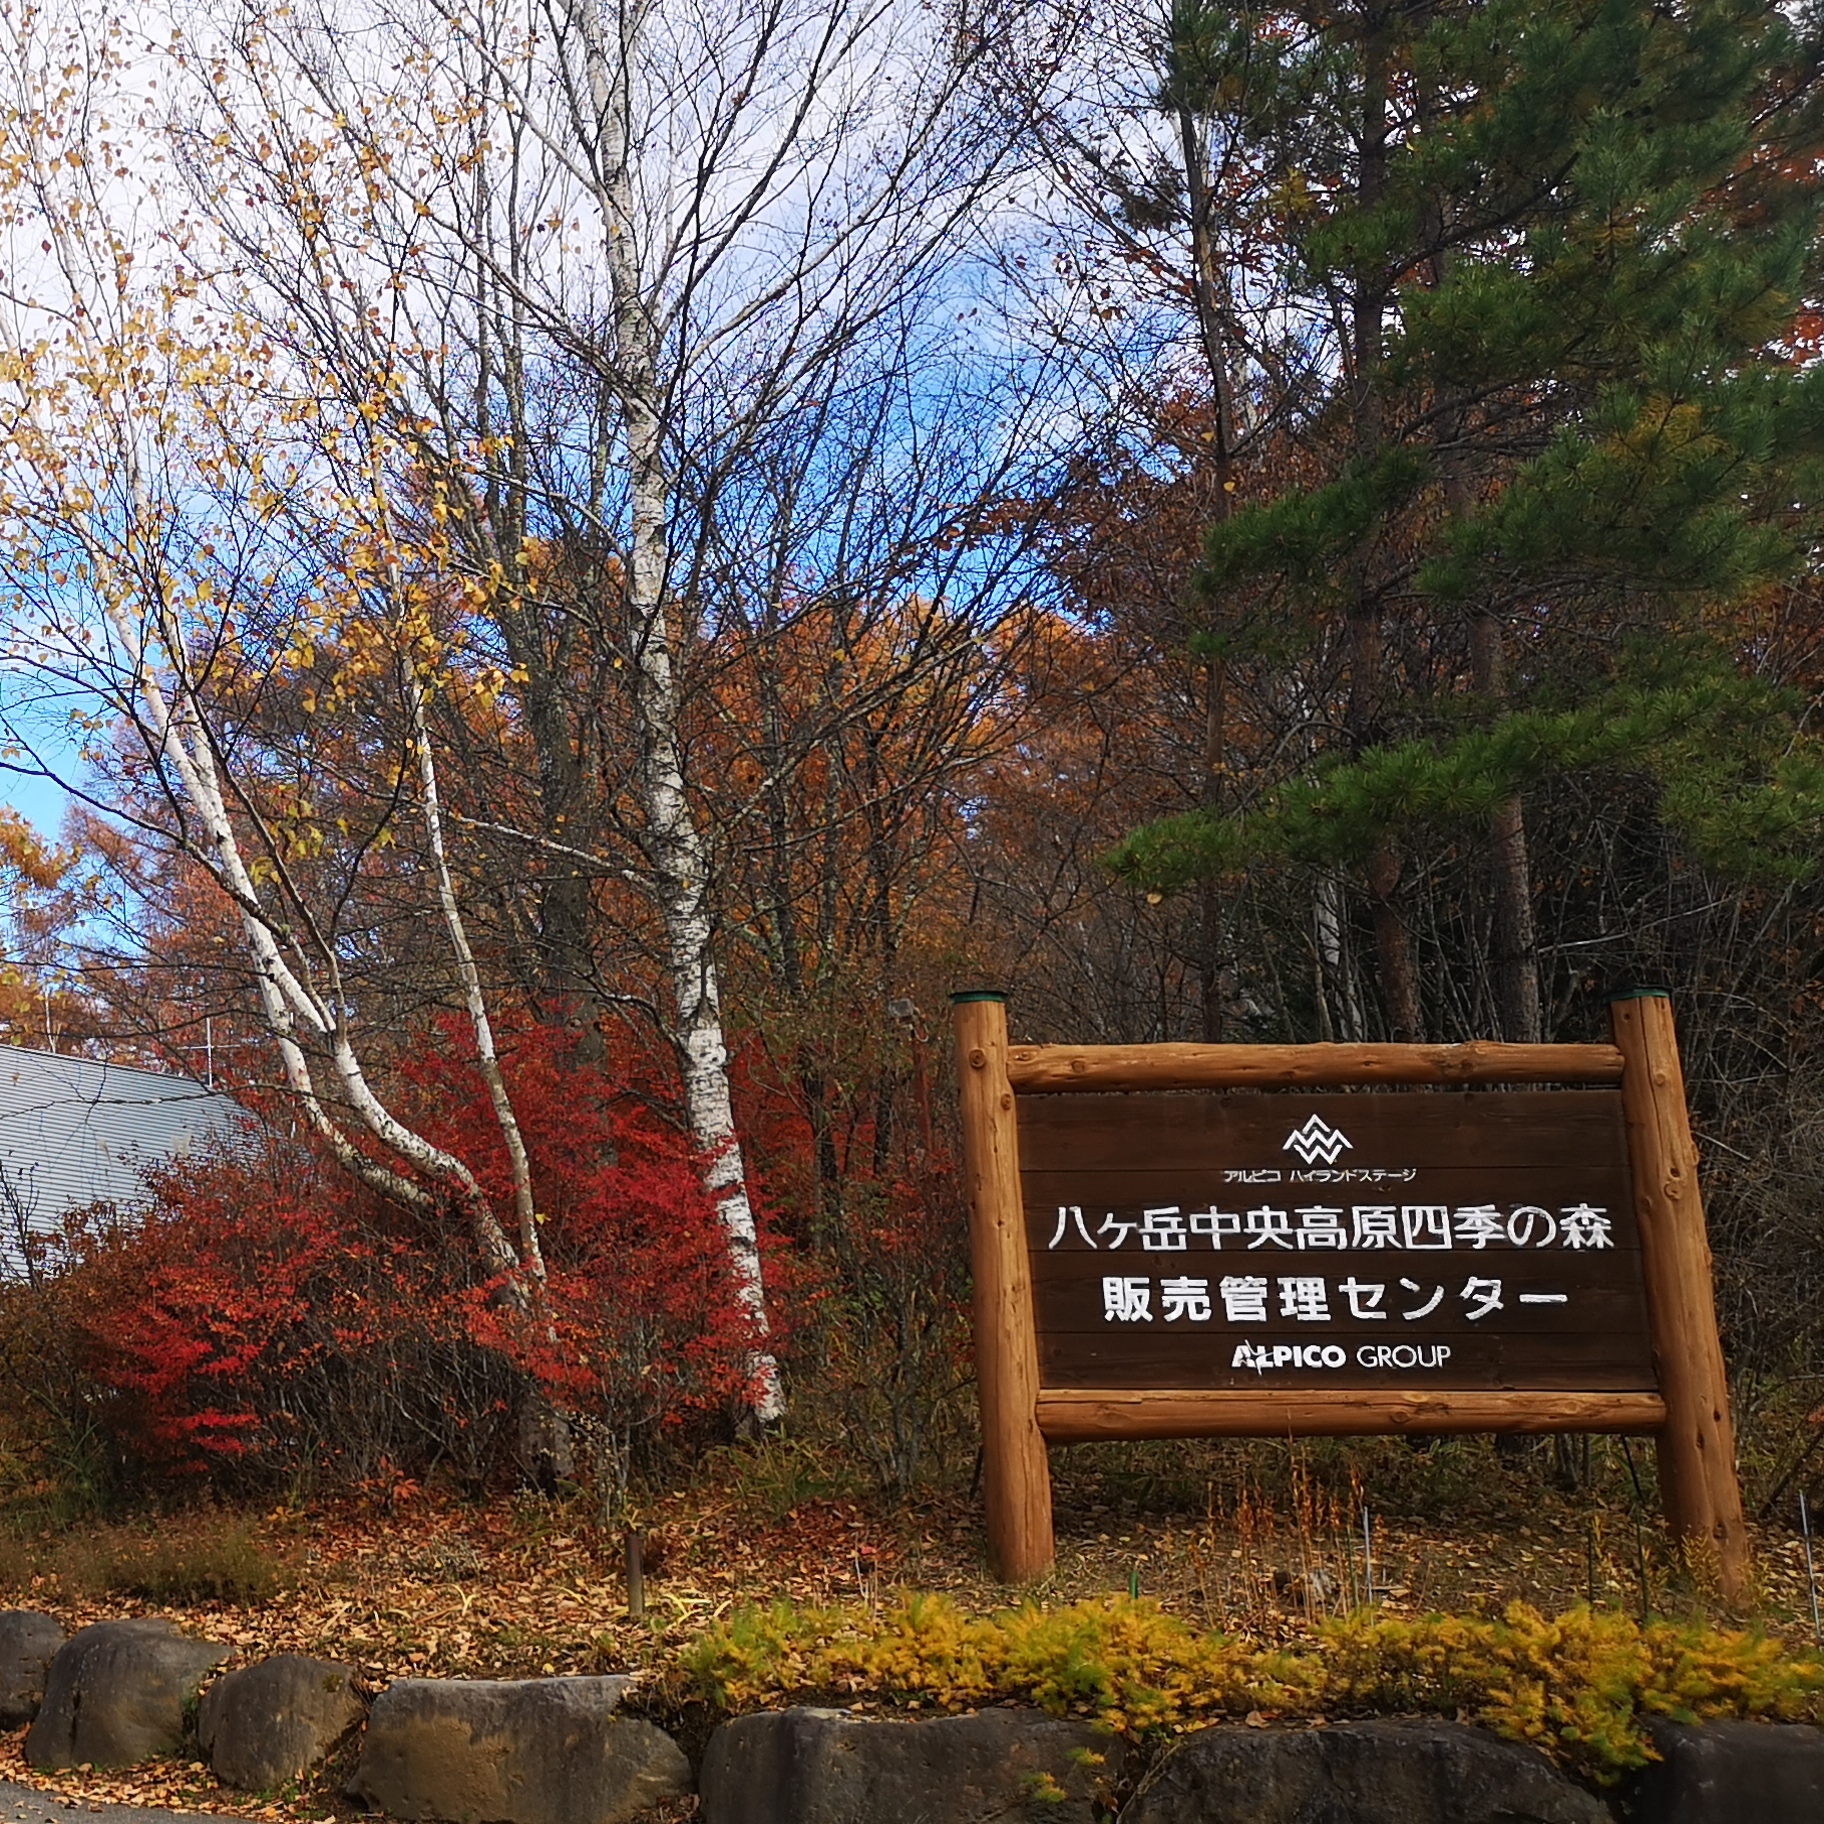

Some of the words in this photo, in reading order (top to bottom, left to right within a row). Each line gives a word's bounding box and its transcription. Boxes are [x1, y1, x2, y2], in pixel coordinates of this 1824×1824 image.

[1223, 1168, 1281, 1183] アルピコ
[1289, 1168, 1417, 1183] ハイランドステージ
[1102, 1276, 1568, 1322] 販売管理センター
[1231, 1340, 1347, 1376] ALPICO
[1356, 1344, 1452, 1369] GROUP
